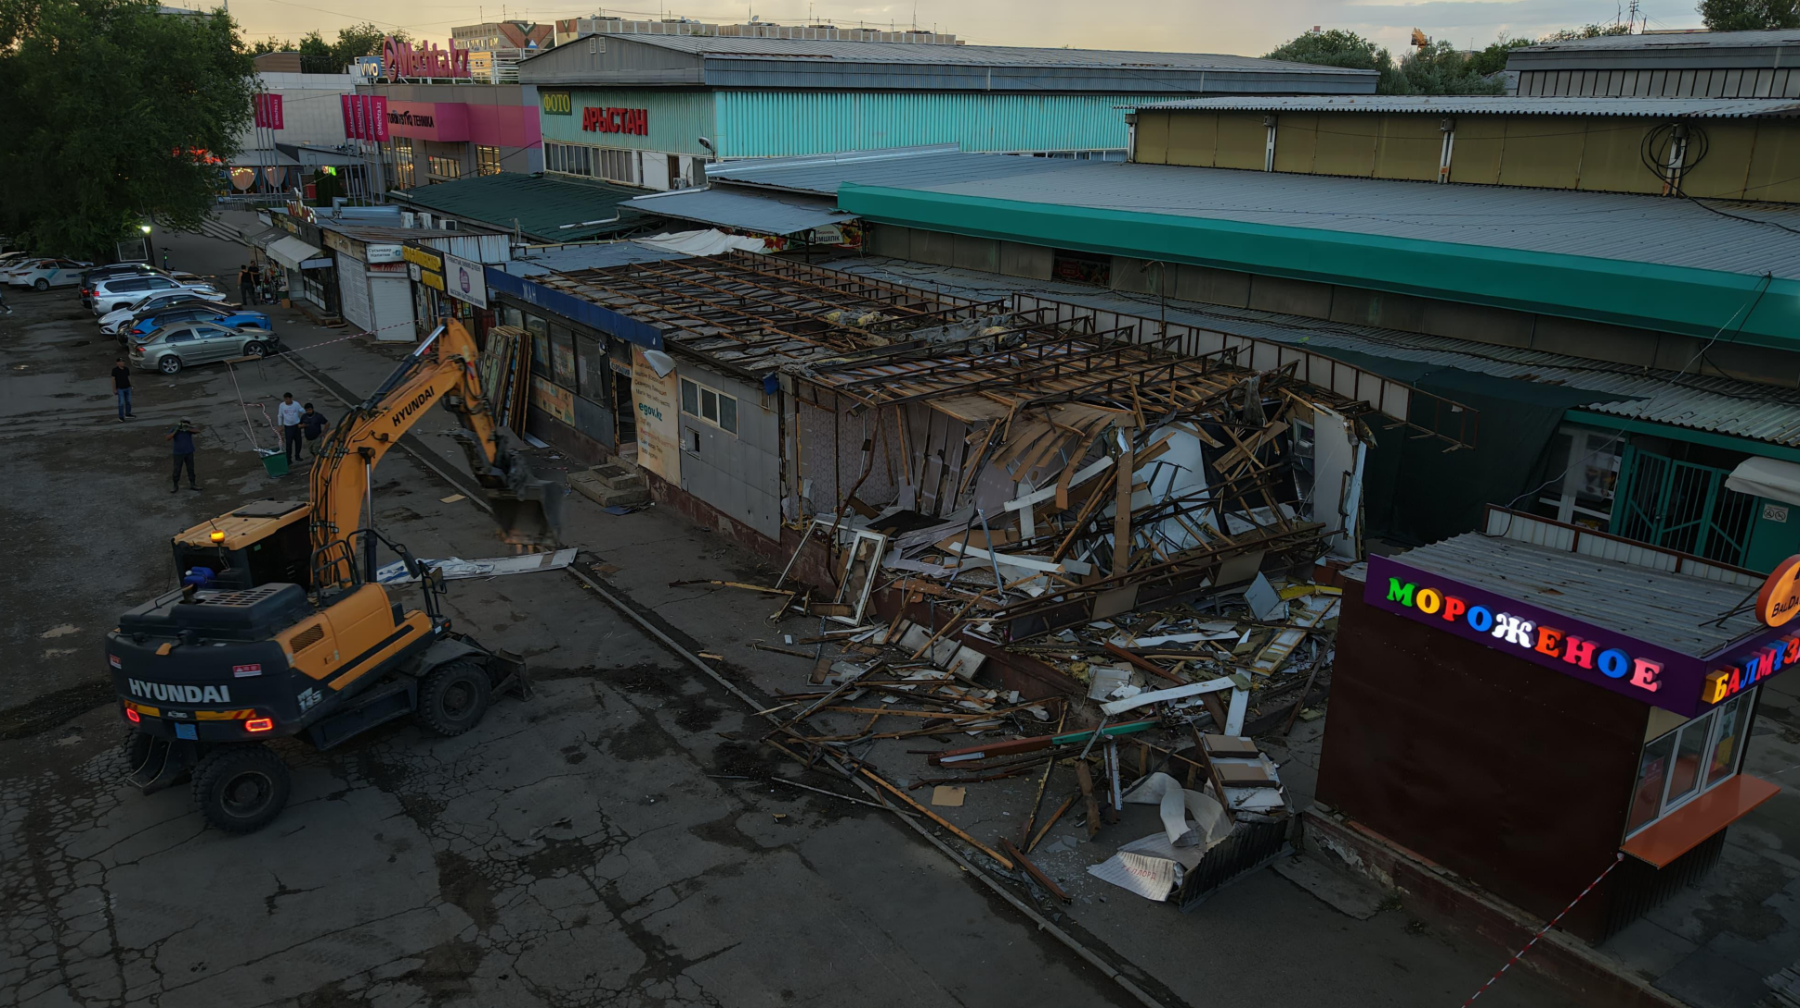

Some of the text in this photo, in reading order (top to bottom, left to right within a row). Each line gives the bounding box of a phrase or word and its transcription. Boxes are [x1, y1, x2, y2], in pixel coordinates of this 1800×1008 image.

[360, 60, 379, 77] vivo
[398, 38, 471, 78] Mechta.kz
[543, 93, 571, 113] ФОТО
[582, 106, 648, 136] АРЫСТАН
[392, 385, 435, 427] HYUNDAI
[638, 402, 663, 422] egov.kz
[1386, 577, 1664, 692] МОРОЖЕНОЕ
[128, 677, 231, 704] HYUNDAI
